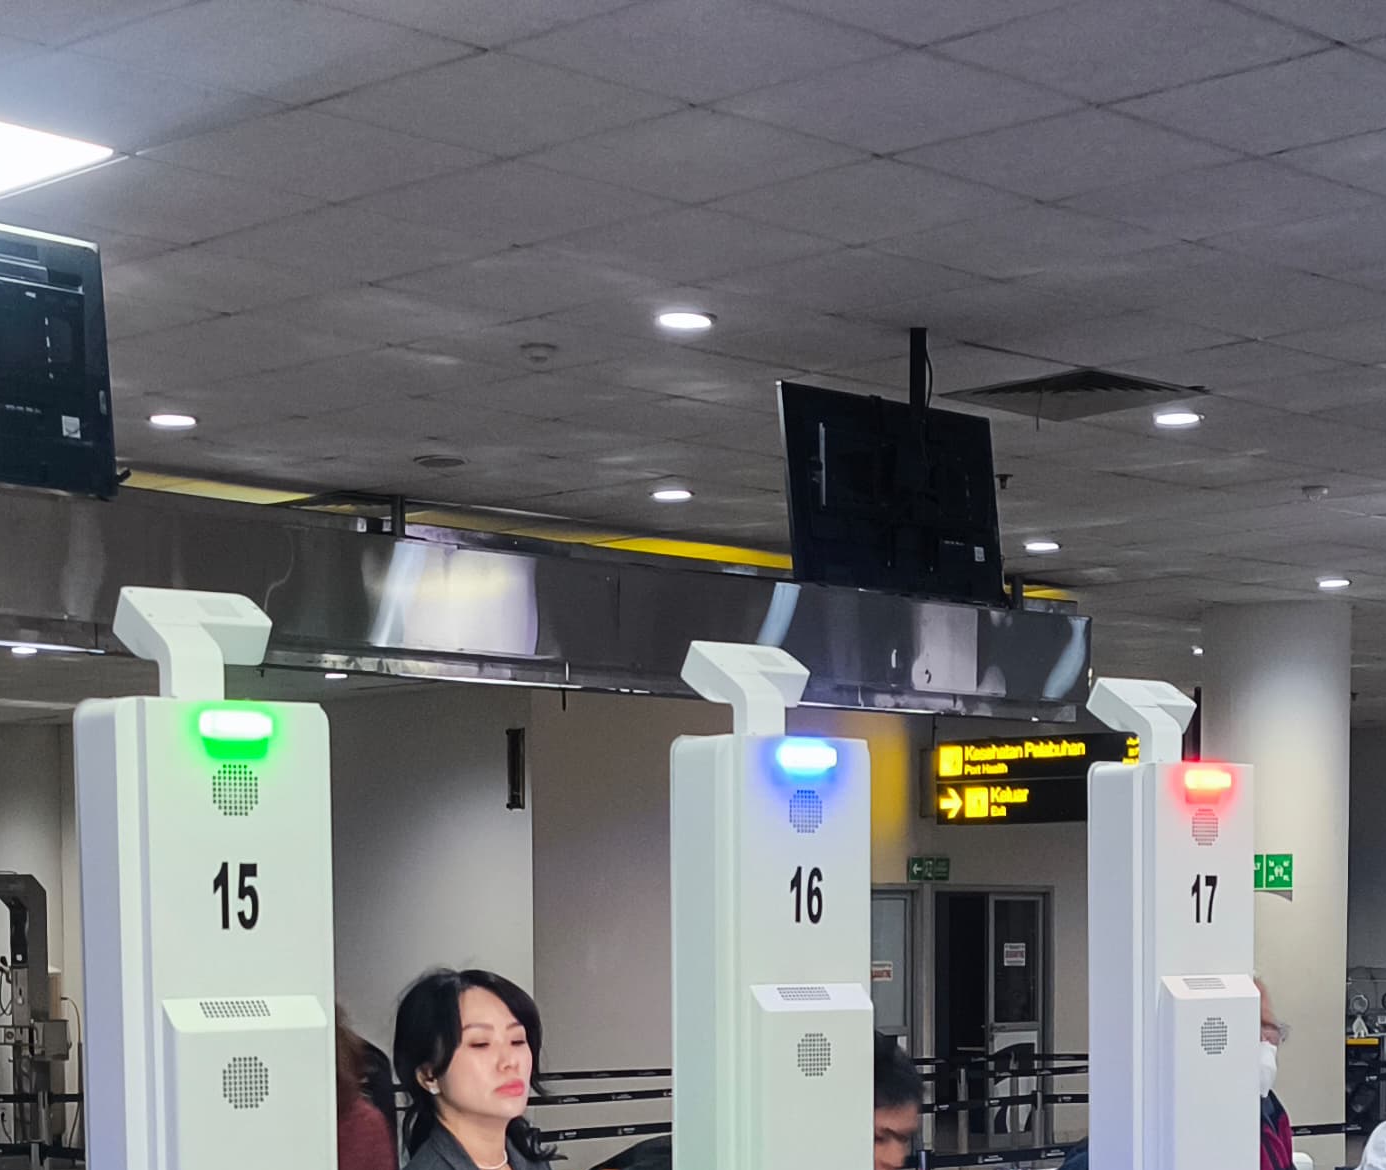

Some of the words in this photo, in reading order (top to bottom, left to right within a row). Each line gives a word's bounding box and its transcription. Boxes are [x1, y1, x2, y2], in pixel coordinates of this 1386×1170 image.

[964, 744, 1023, 761] Kesehatan
[1024, 739, 1086, 758] Pelabuhan
[990, 786, 1029, 803] Keluar
[213, 861, 259, 930] 15
[790, 865, 823, 924] 16
[1191, 874, 1217, 923] 17
